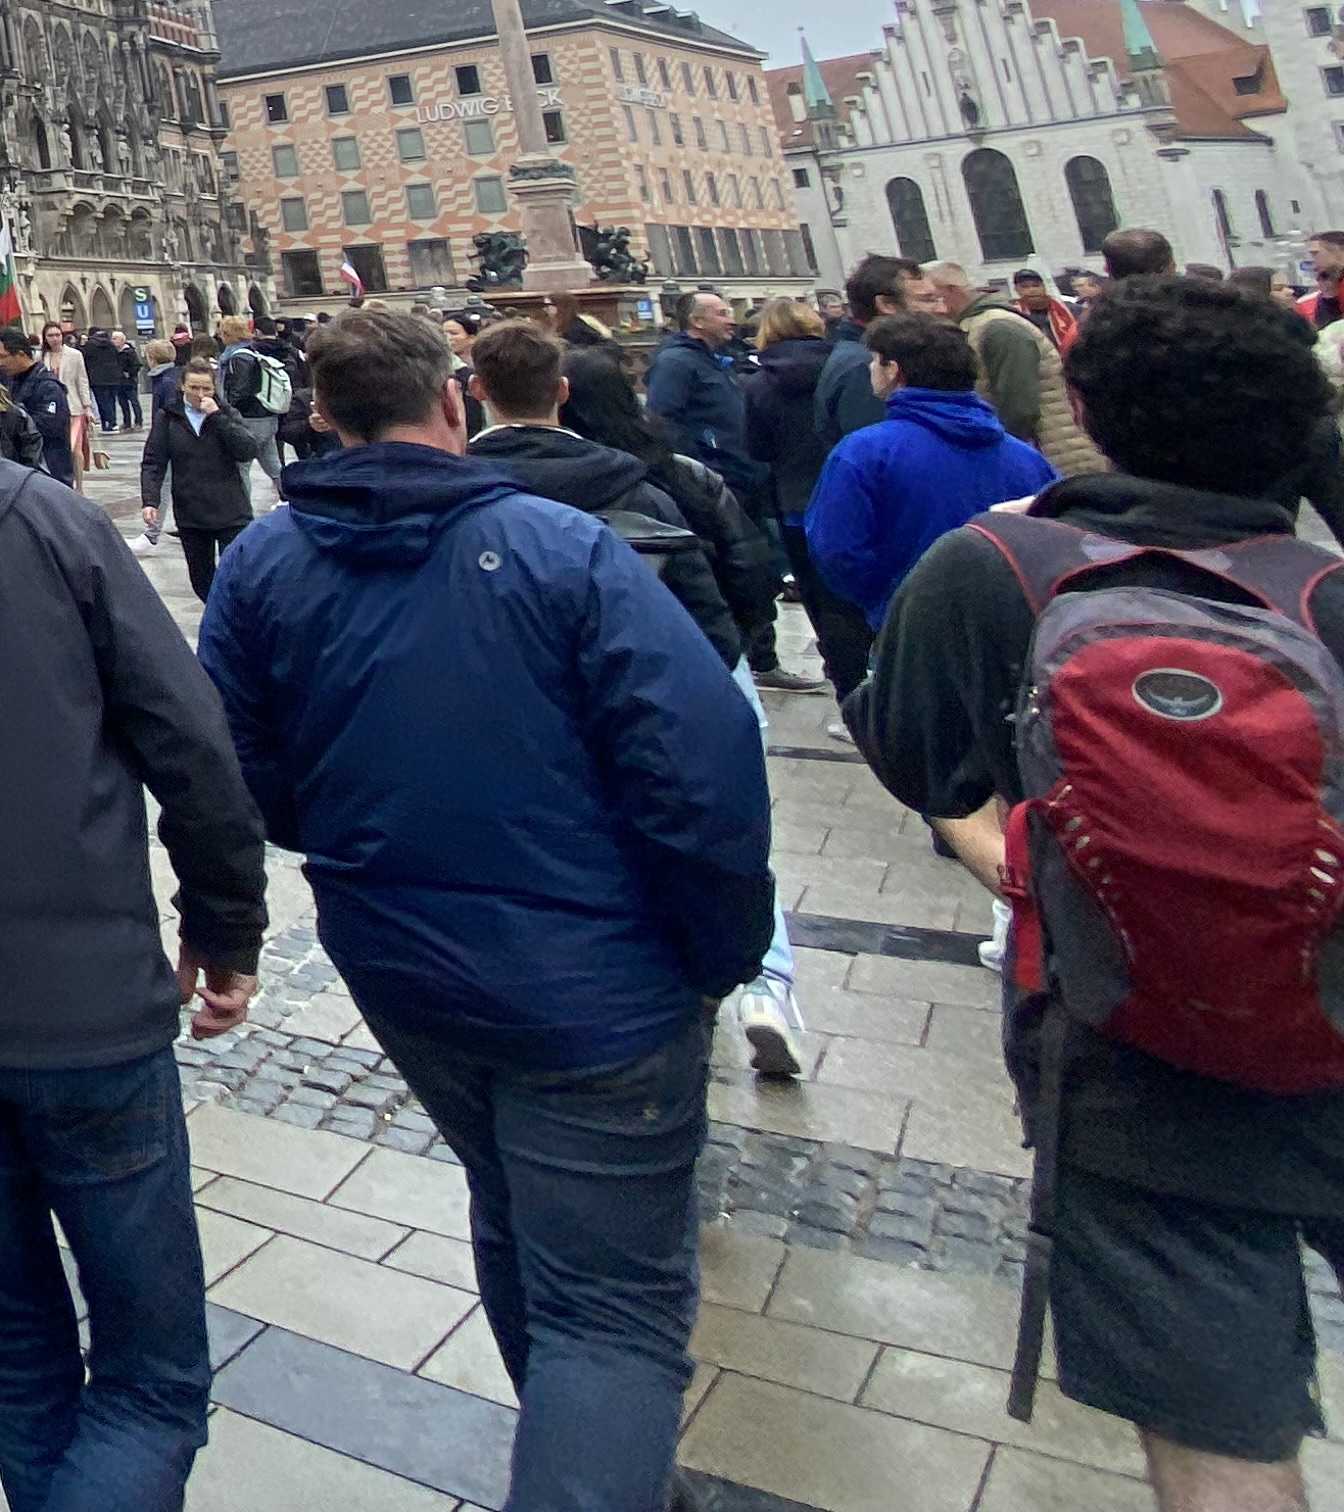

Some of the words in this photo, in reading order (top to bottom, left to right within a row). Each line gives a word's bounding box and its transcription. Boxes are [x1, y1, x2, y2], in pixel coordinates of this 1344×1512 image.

[416, 97, 500, 124] LUDWIG
[135, 288, 147, 301] S
[137, 305, 148, 318] U
